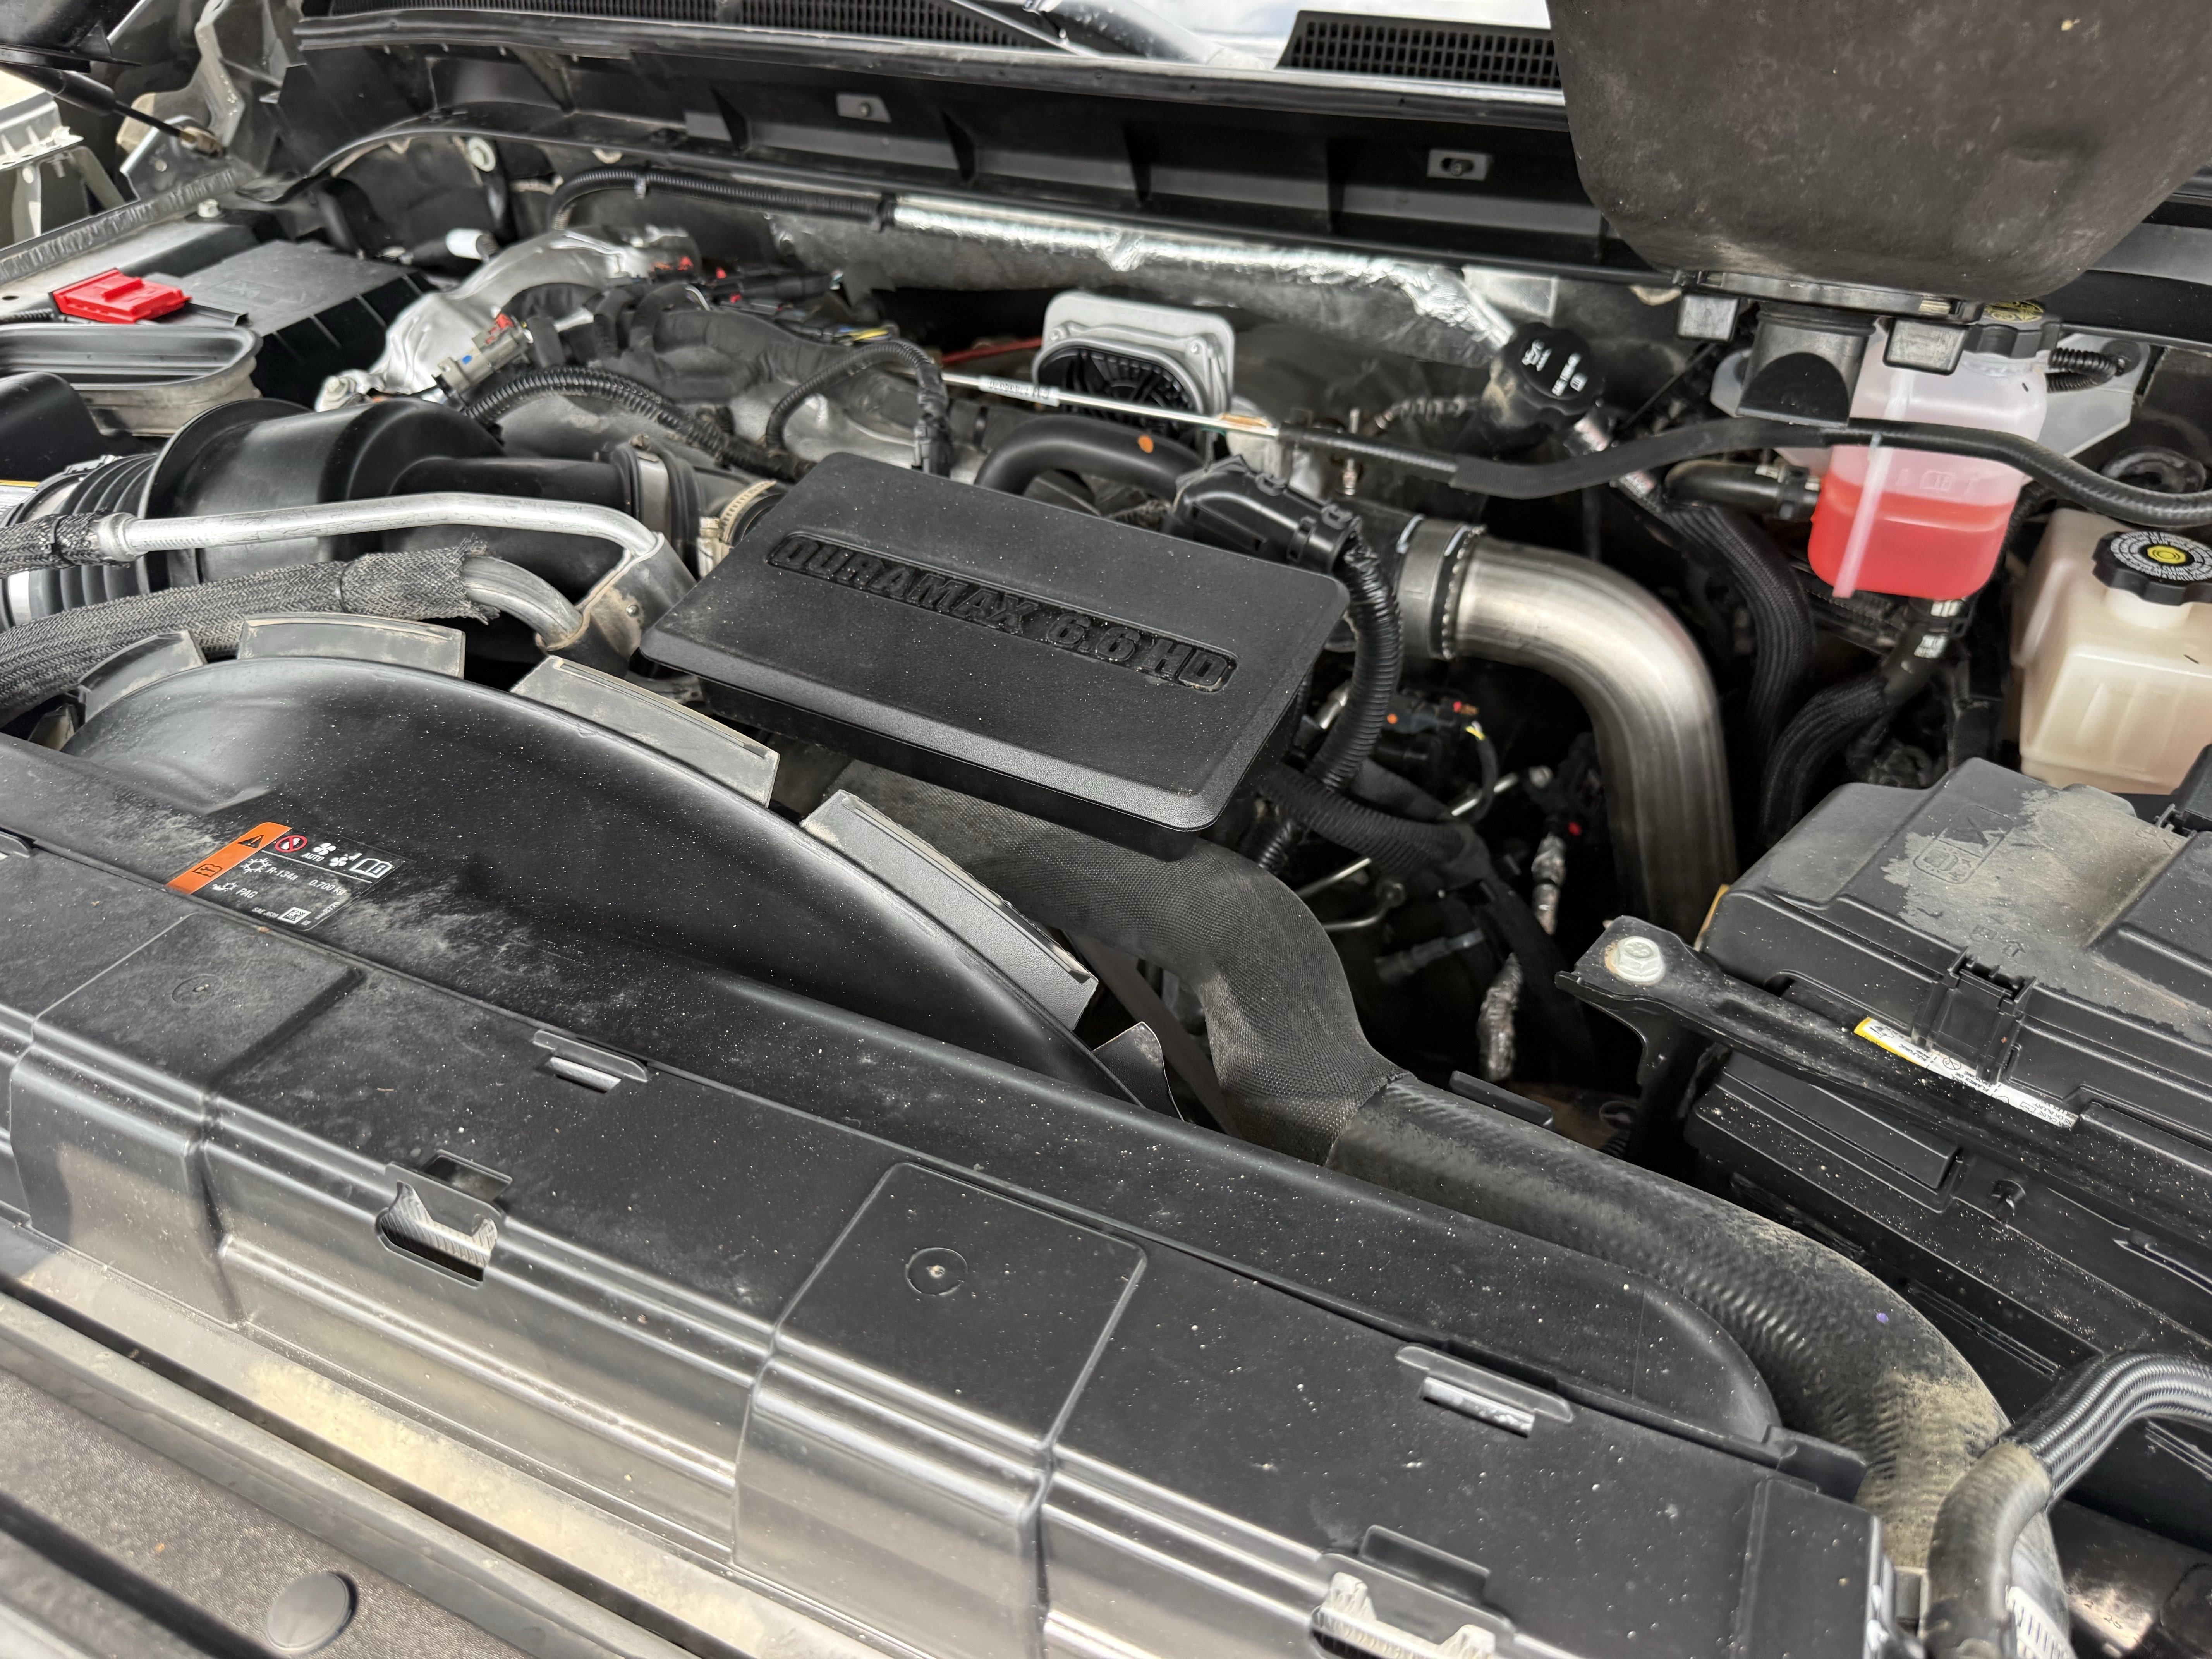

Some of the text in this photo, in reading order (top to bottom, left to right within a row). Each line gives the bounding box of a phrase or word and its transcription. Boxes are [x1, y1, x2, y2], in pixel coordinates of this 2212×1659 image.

[773, 536, 1229, 687] DURAMAX 6.6 HD
[300, 853, 325, 862] AUTO
[266, 867, 298, 881] R-134a
[309, 879, 335, 891] 0.700
[235, 888, 258, 898] PAG
